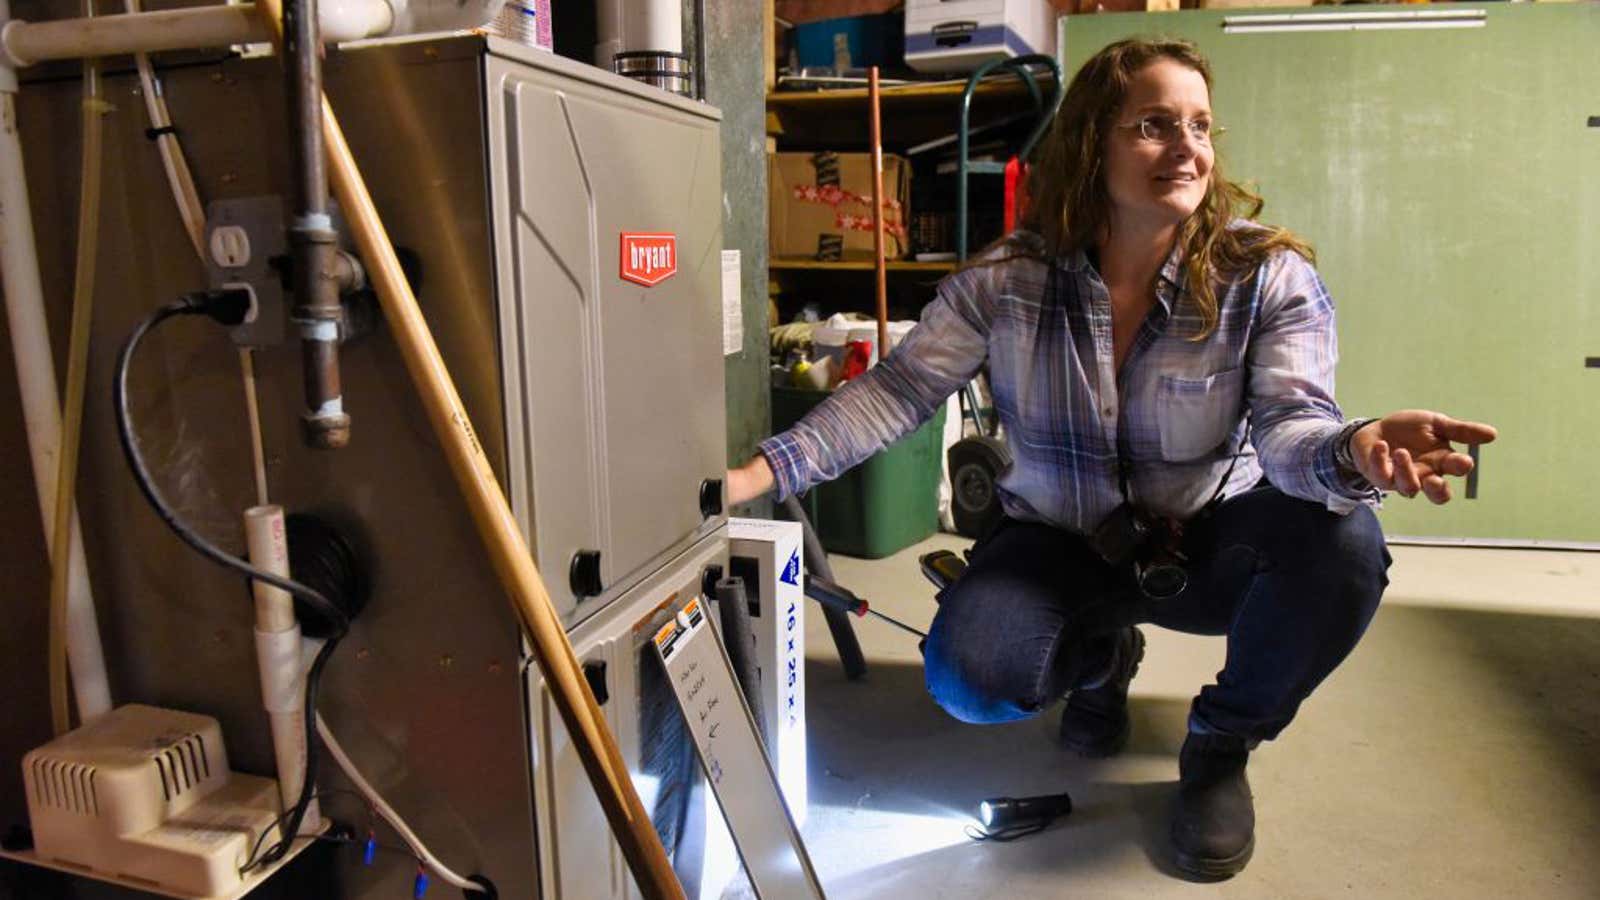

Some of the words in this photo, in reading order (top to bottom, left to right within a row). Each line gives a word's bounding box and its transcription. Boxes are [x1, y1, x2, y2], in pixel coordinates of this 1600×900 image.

[630, 241, 671, 274] bryant
[787, 602, 796, 631] 16
[788, 657, 797, 688] 25
